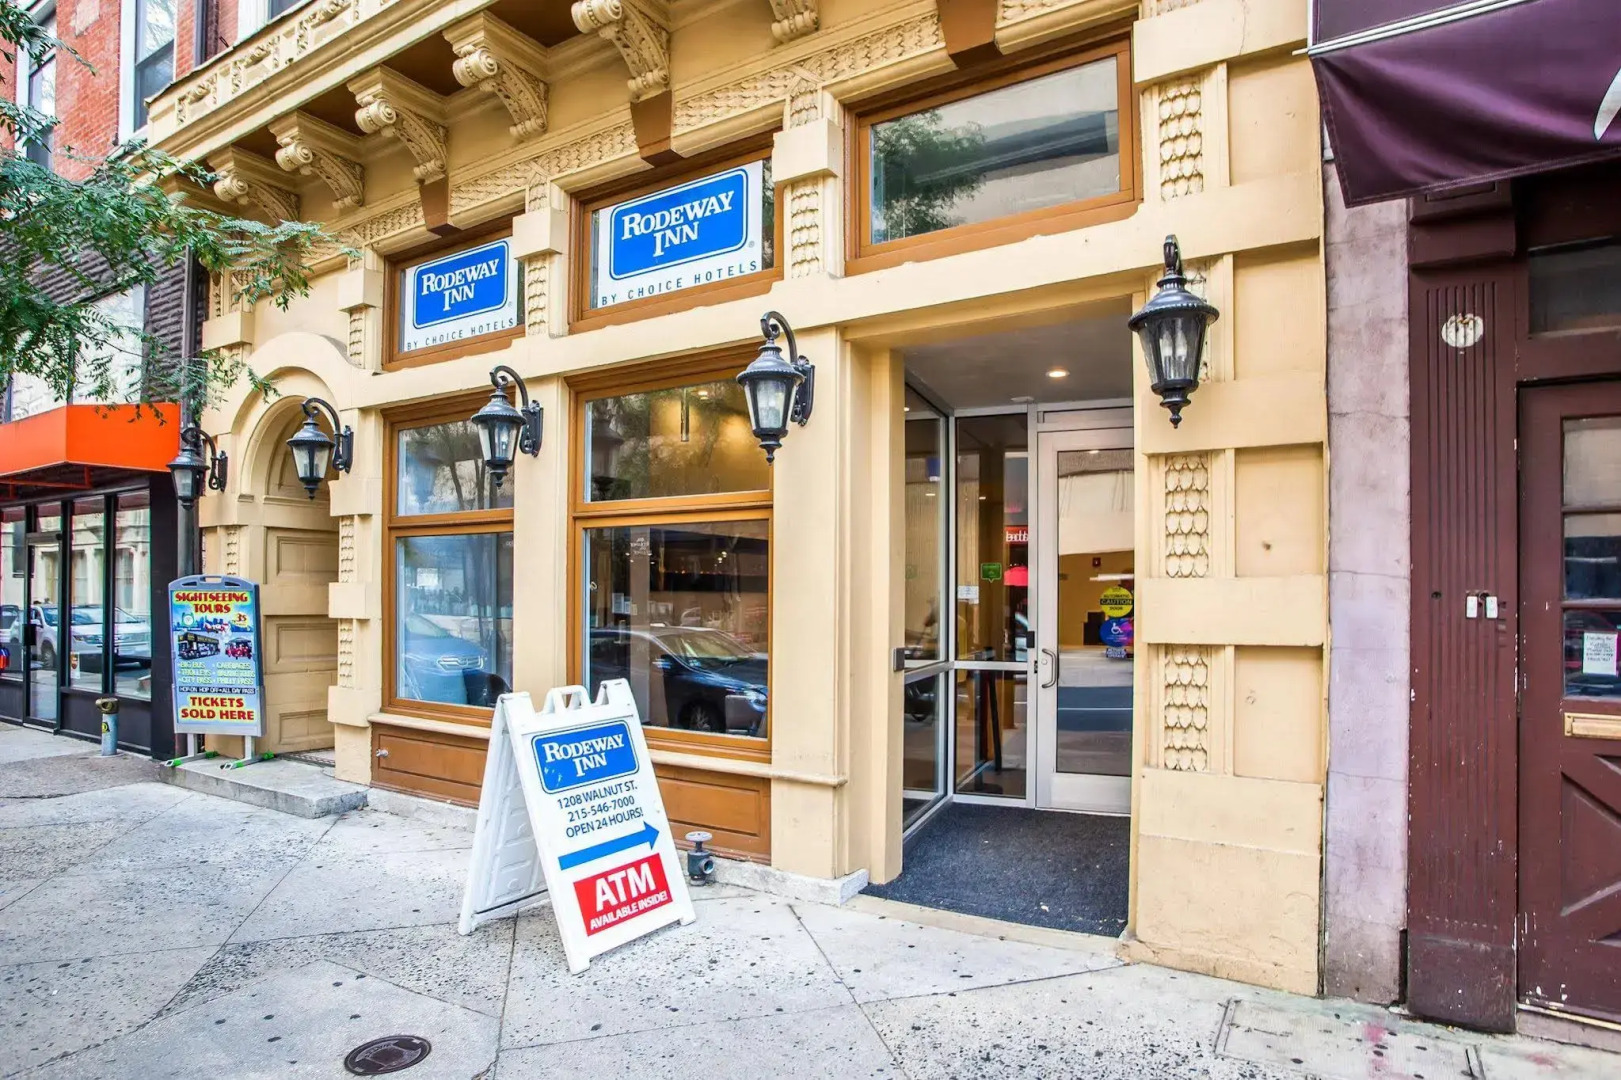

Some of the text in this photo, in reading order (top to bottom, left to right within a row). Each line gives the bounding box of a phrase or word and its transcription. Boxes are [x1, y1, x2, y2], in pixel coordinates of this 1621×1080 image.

[621, 190, 735, 241] RODEWAY
[653, 221, 699, 258] INN
[421, 258, 499, 296] RODEWAY
[601, 260, 757, 306] BY CHOICE HOTELS
[443, 282, 475, 311] INN
[407, 317, 514, 351] BY CHOICE HOTELS
[175, 591, 248, 602] SIGHTSEEING
[193, 603, 231, 614] TOURS
[192, 661, 206, 670] BUS
[180, 676, 213, 685] CITY PASS
[237, 678, 254, 686] PASS
[181, 708, 254, 721] SOLD HERE
[190, 696, 244, 708] TICKETS
[542, 733, 624, 763] RODEWAY
[572, 752, 608, 777] INN
[557, 780, 638, 810] 1208 WALNUT ST.
[568, 795, 635, 822] 215-546-7000
[566, 806, 644, 838] OPEN 24 HOURS!
[596, 862, 656, 912] ATM
[590, 902, 638, 931] AVAILABLE
